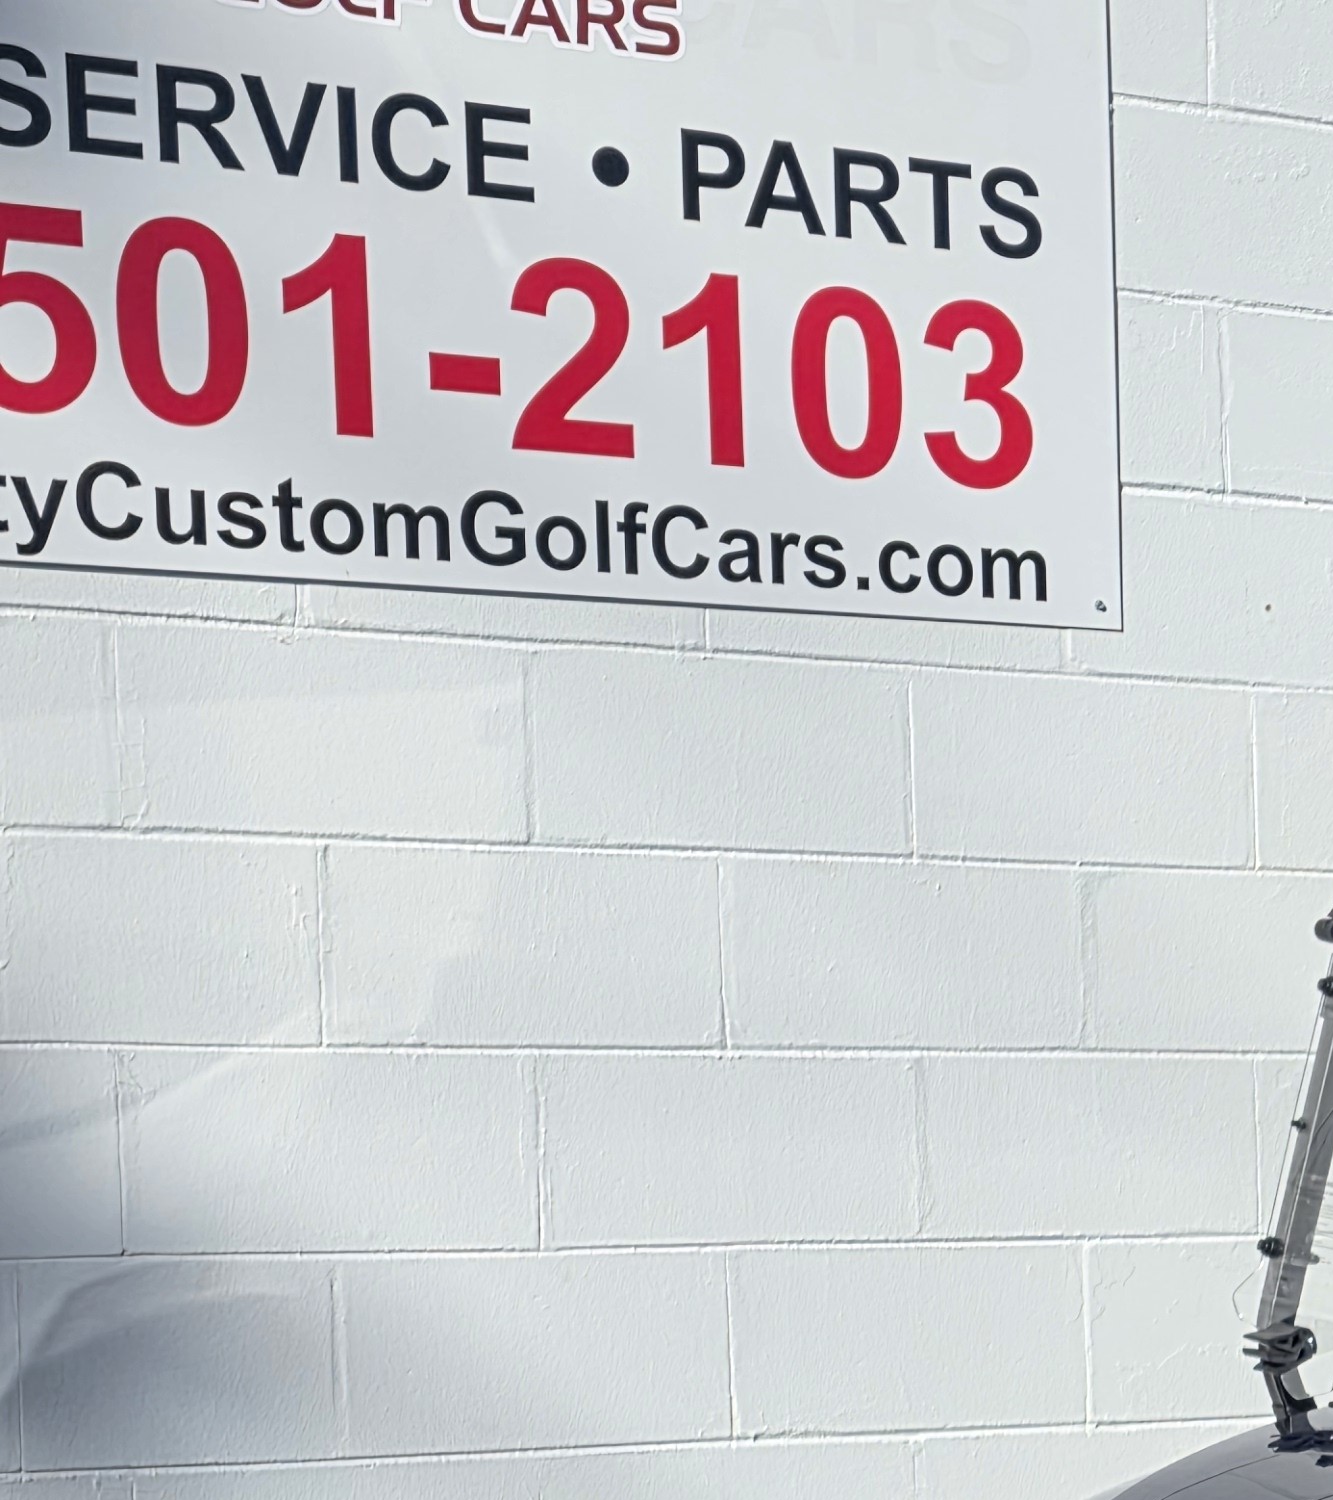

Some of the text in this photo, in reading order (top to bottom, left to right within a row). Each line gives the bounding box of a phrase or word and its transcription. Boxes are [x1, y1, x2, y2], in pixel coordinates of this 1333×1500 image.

[459, 0, 682, 57] CARS
[0, 44, 1043, 260] SERVICE PARTS
[0, 204, 1034, 490] 501-2103
